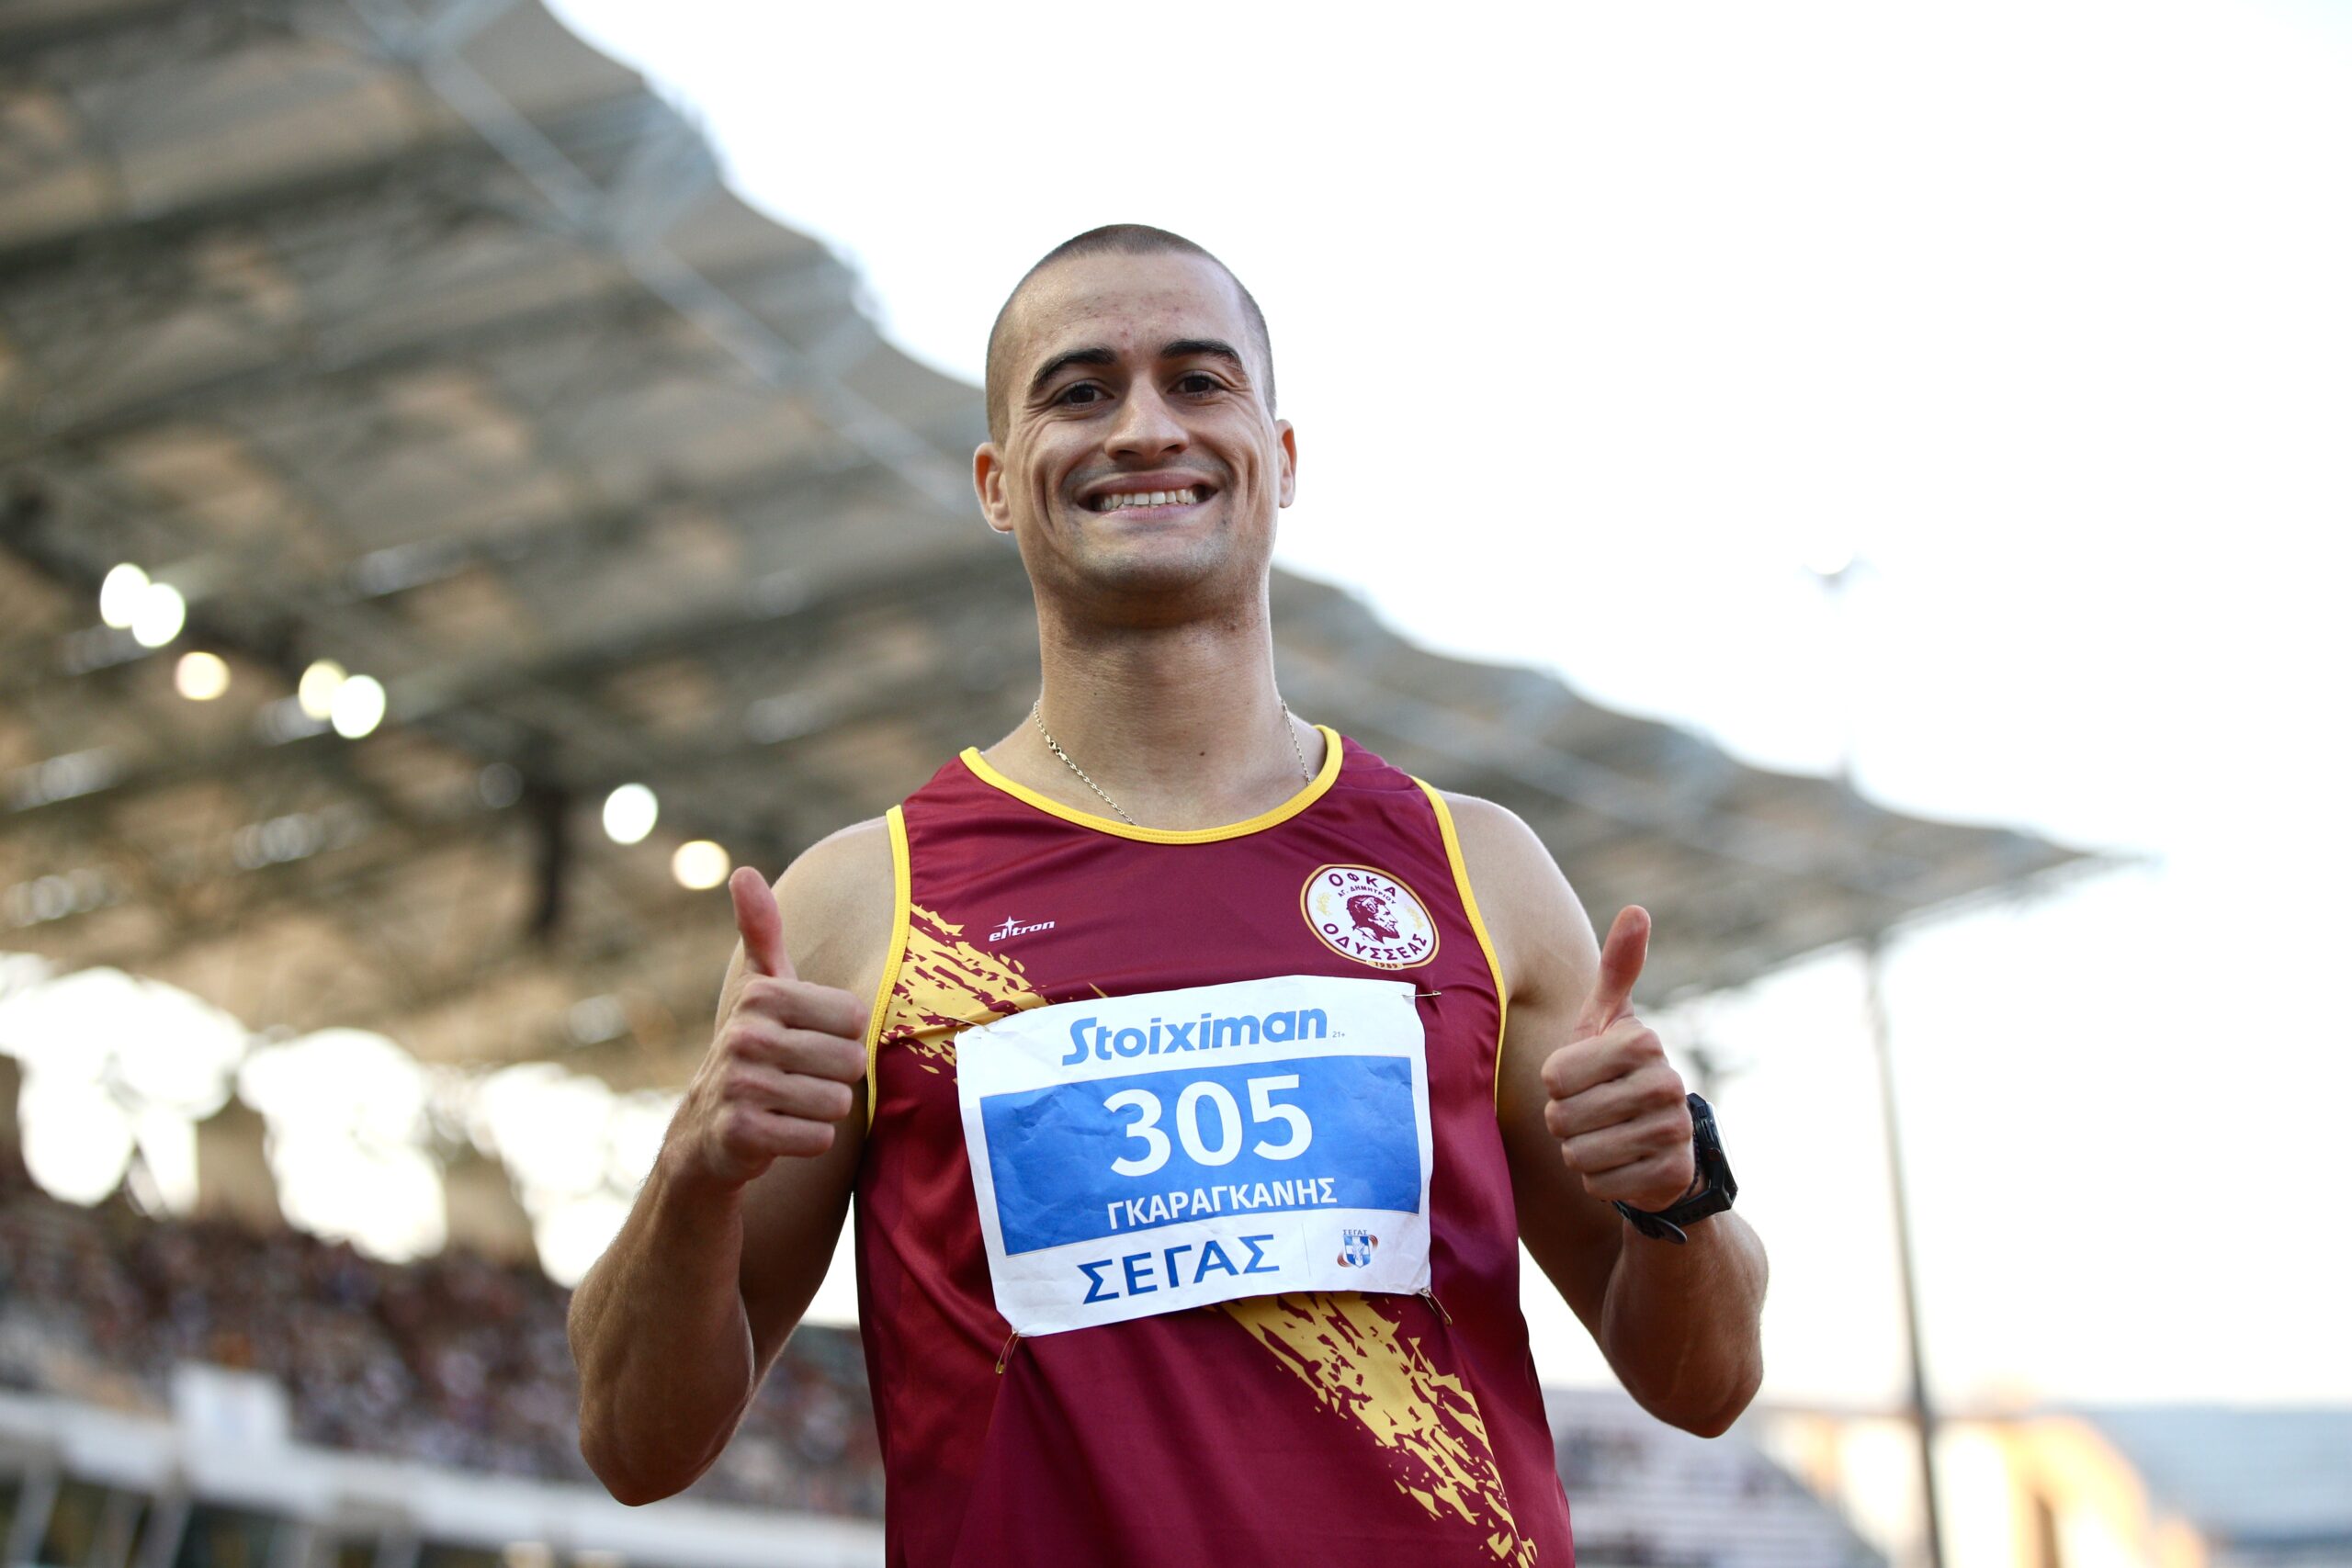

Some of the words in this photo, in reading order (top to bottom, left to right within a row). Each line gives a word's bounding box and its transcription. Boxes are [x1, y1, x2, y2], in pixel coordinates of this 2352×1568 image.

[1329, 873, 1396, 897] ΟΦΚΑ
[1350, 886, 1396, 905] ΔΗΜΗΤΡΙΟΥ
[1323, 923, 1427, 961] ΟΔΥΣΣΕΑΣ
[1061, 1008, 1328, 1066] Stoiximan
[1102, 1074, 1313, 1178] 305
[1107, 1178, 1338, 1230] ΓΚΑΡΑΓΚΑΝΗΣ
[1077, 1234, 1280, 1304] ΣΕΓΑΣ
